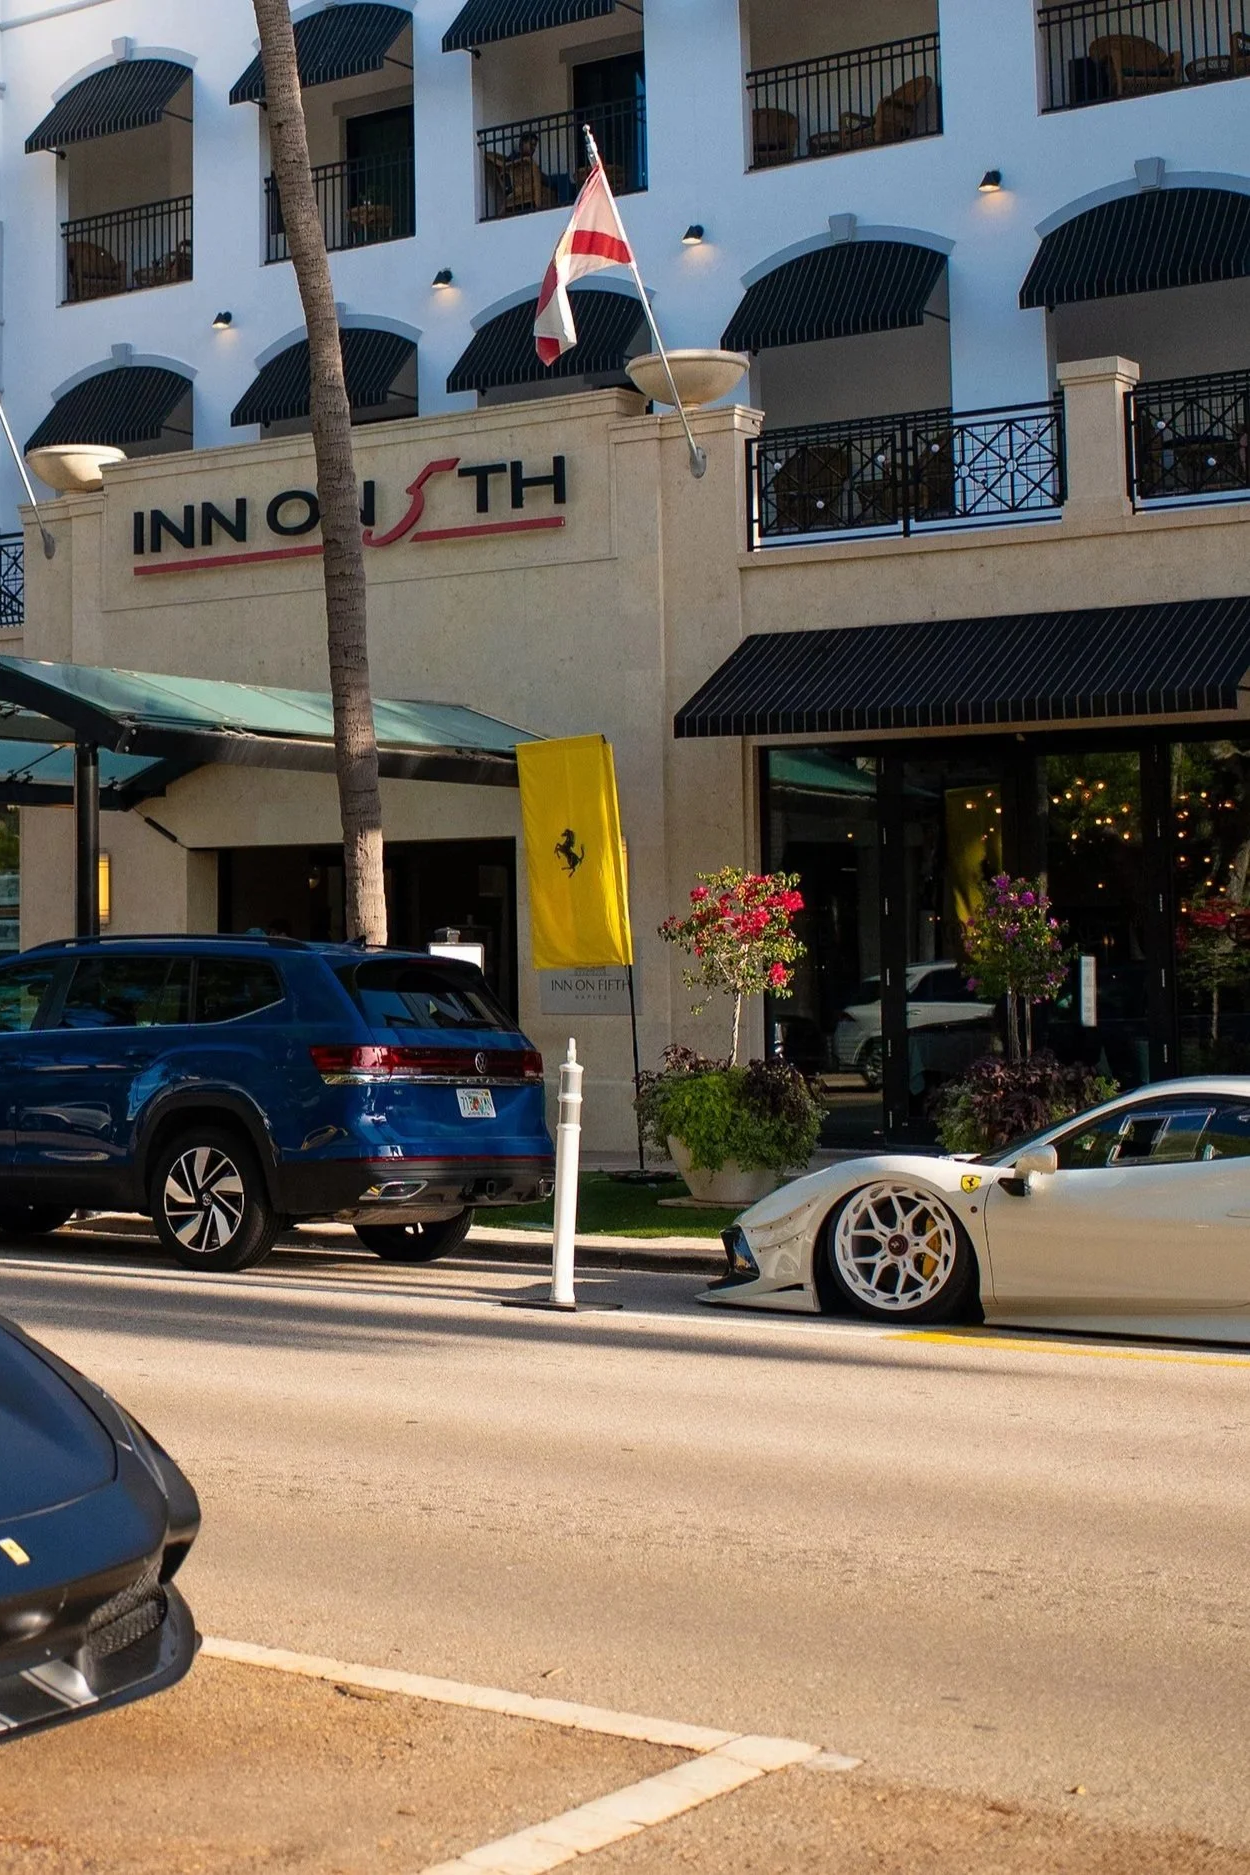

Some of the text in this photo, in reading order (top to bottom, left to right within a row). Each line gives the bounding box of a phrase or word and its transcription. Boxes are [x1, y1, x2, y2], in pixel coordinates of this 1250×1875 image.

[134, 498, 246, 555] INN
[551, 979, 631, 991] INN ON FIFTH
